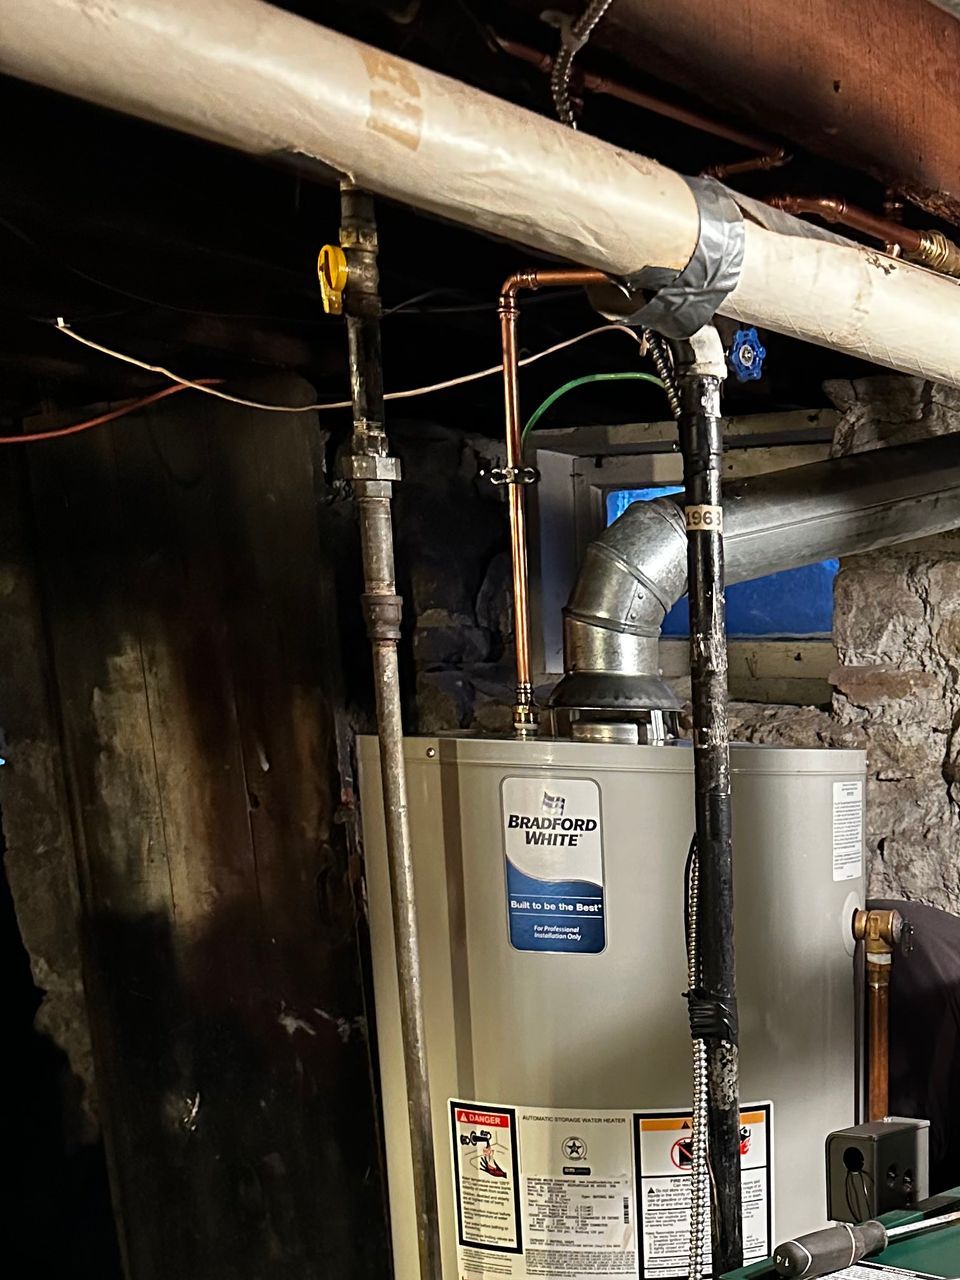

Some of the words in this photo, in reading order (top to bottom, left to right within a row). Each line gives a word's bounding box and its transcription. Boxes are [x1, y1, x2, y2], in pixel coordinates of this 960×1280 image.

[508, 814, 597, 831] BRADFORD
[510, 900, 530, 909] Built
[532, 901, 542, 910] to
[543, 902, 556, 910] be
[558, 902, 574, 911] the
[543, 925, 580, 933] Professional
[533, 932, 567, 940] Installation
[567, 933, 582, 942] Only
[468, 1113, 501, 1125] DANGER
